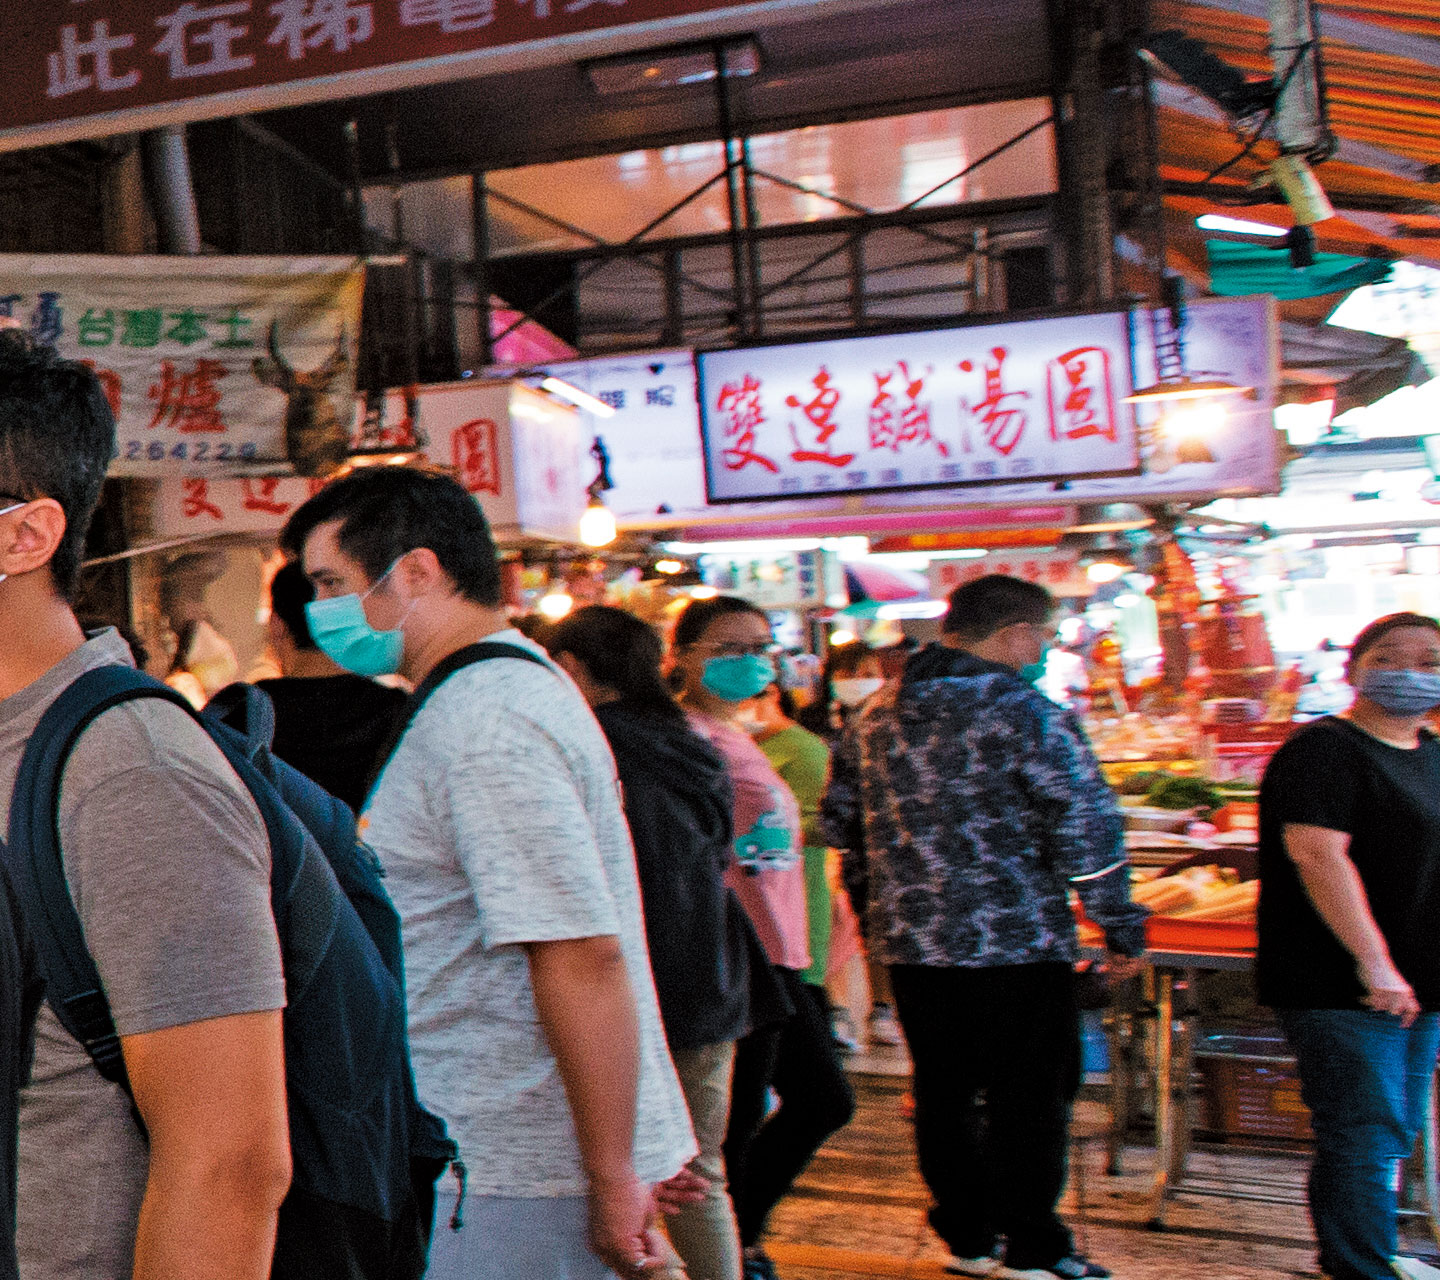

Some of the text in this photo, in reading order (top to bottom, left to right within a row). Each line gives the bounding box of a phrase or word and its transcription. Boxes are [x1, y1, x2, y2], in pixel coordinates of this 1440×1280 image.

[717, 347, 1118, 475] 雙連鹹湯圓
